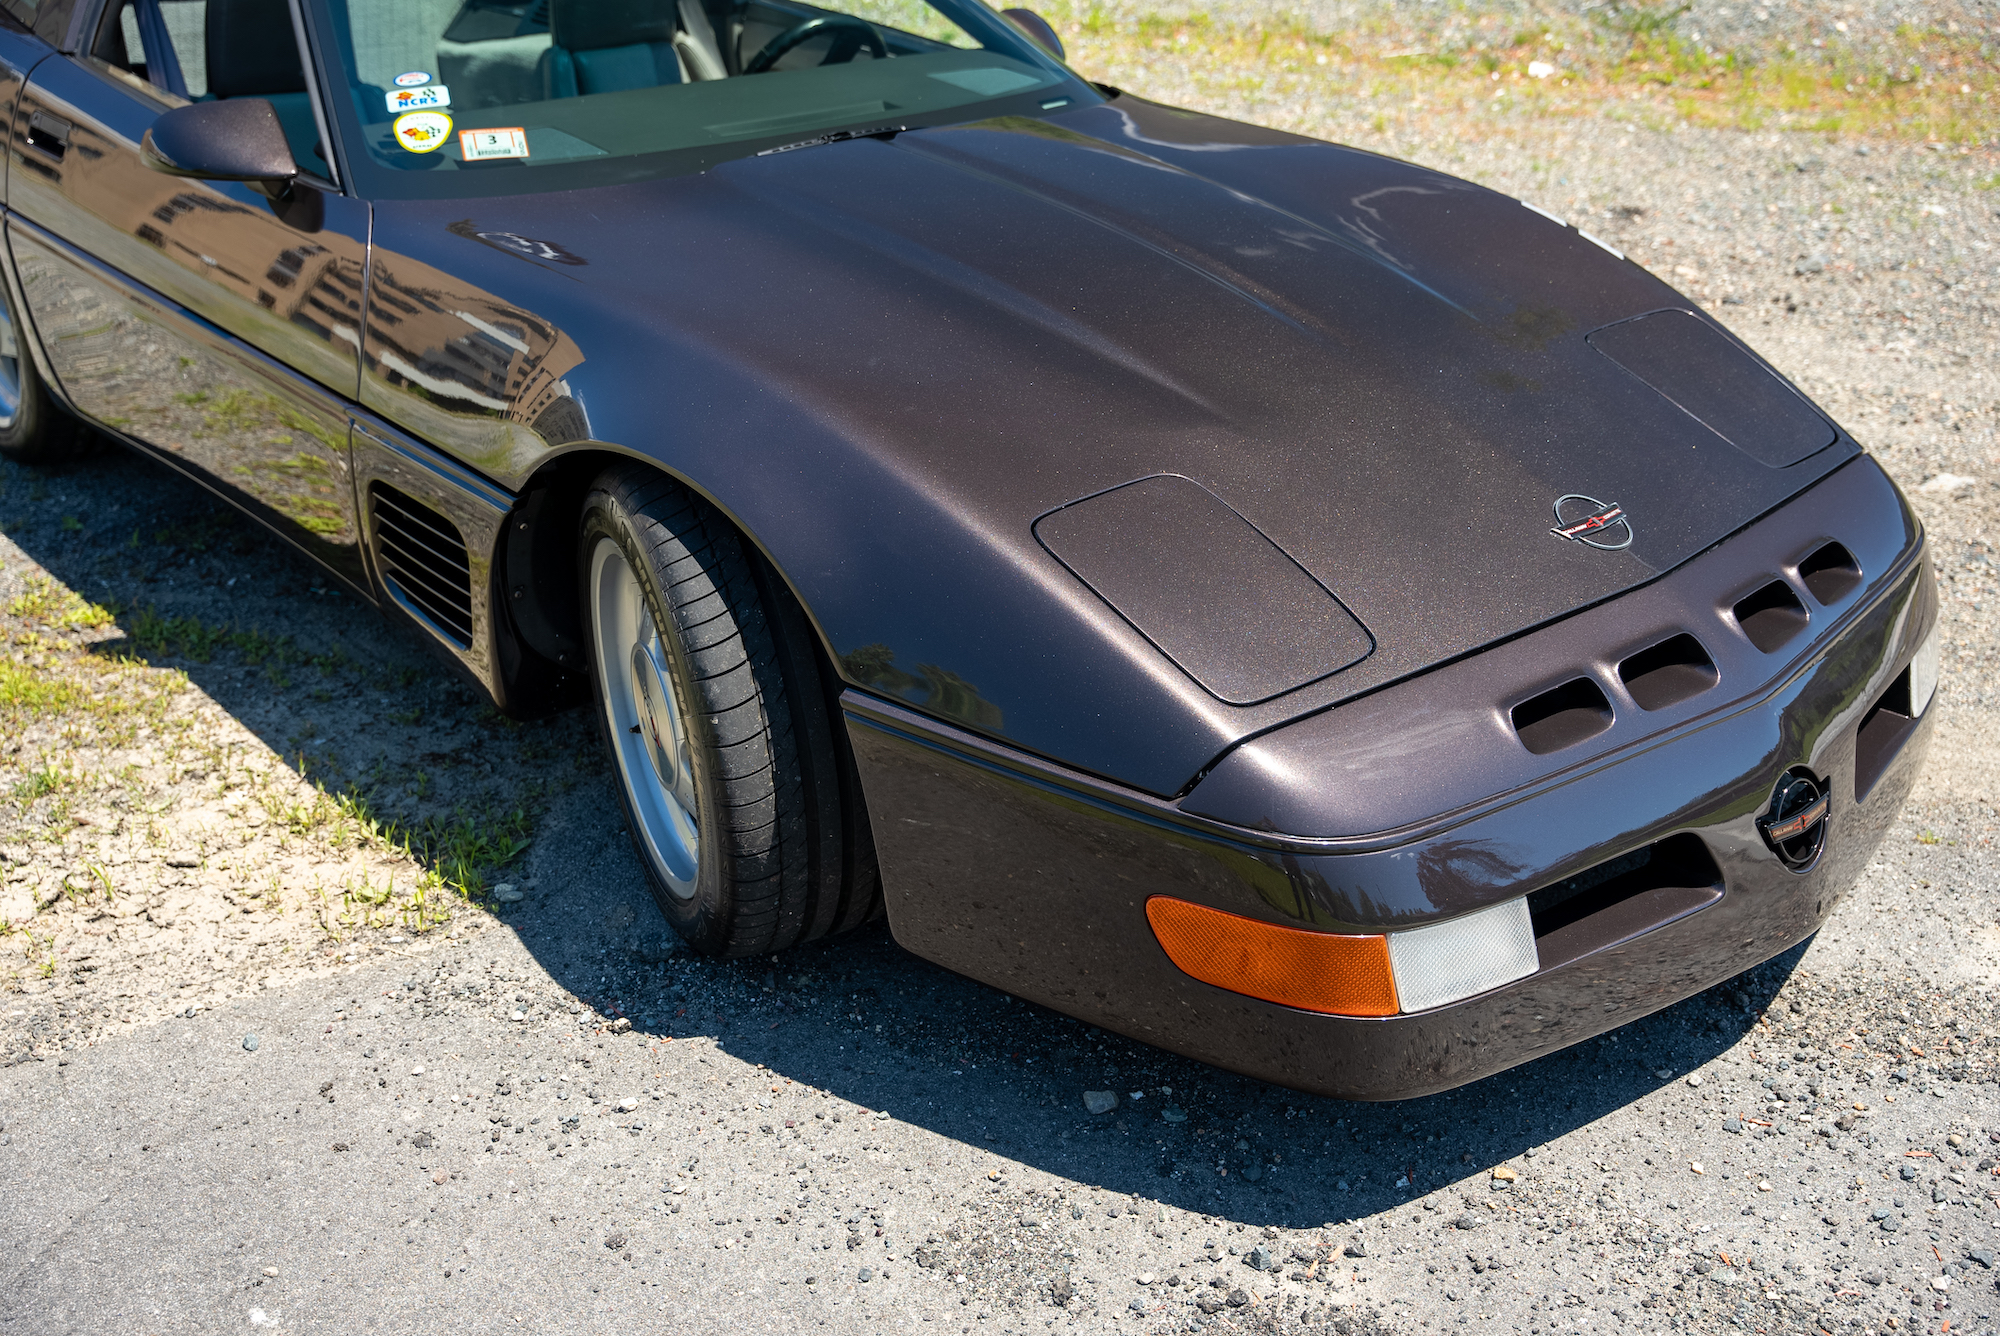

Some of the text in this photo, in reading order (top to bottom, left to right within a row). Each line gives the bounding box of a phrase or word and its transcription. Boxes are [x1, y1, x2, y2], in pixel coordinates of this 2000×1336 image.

[398, 97, 438, 108] NCRS
[488, 134, 497, 145] 3
[634, 556, 688, 711] MICHELIN
